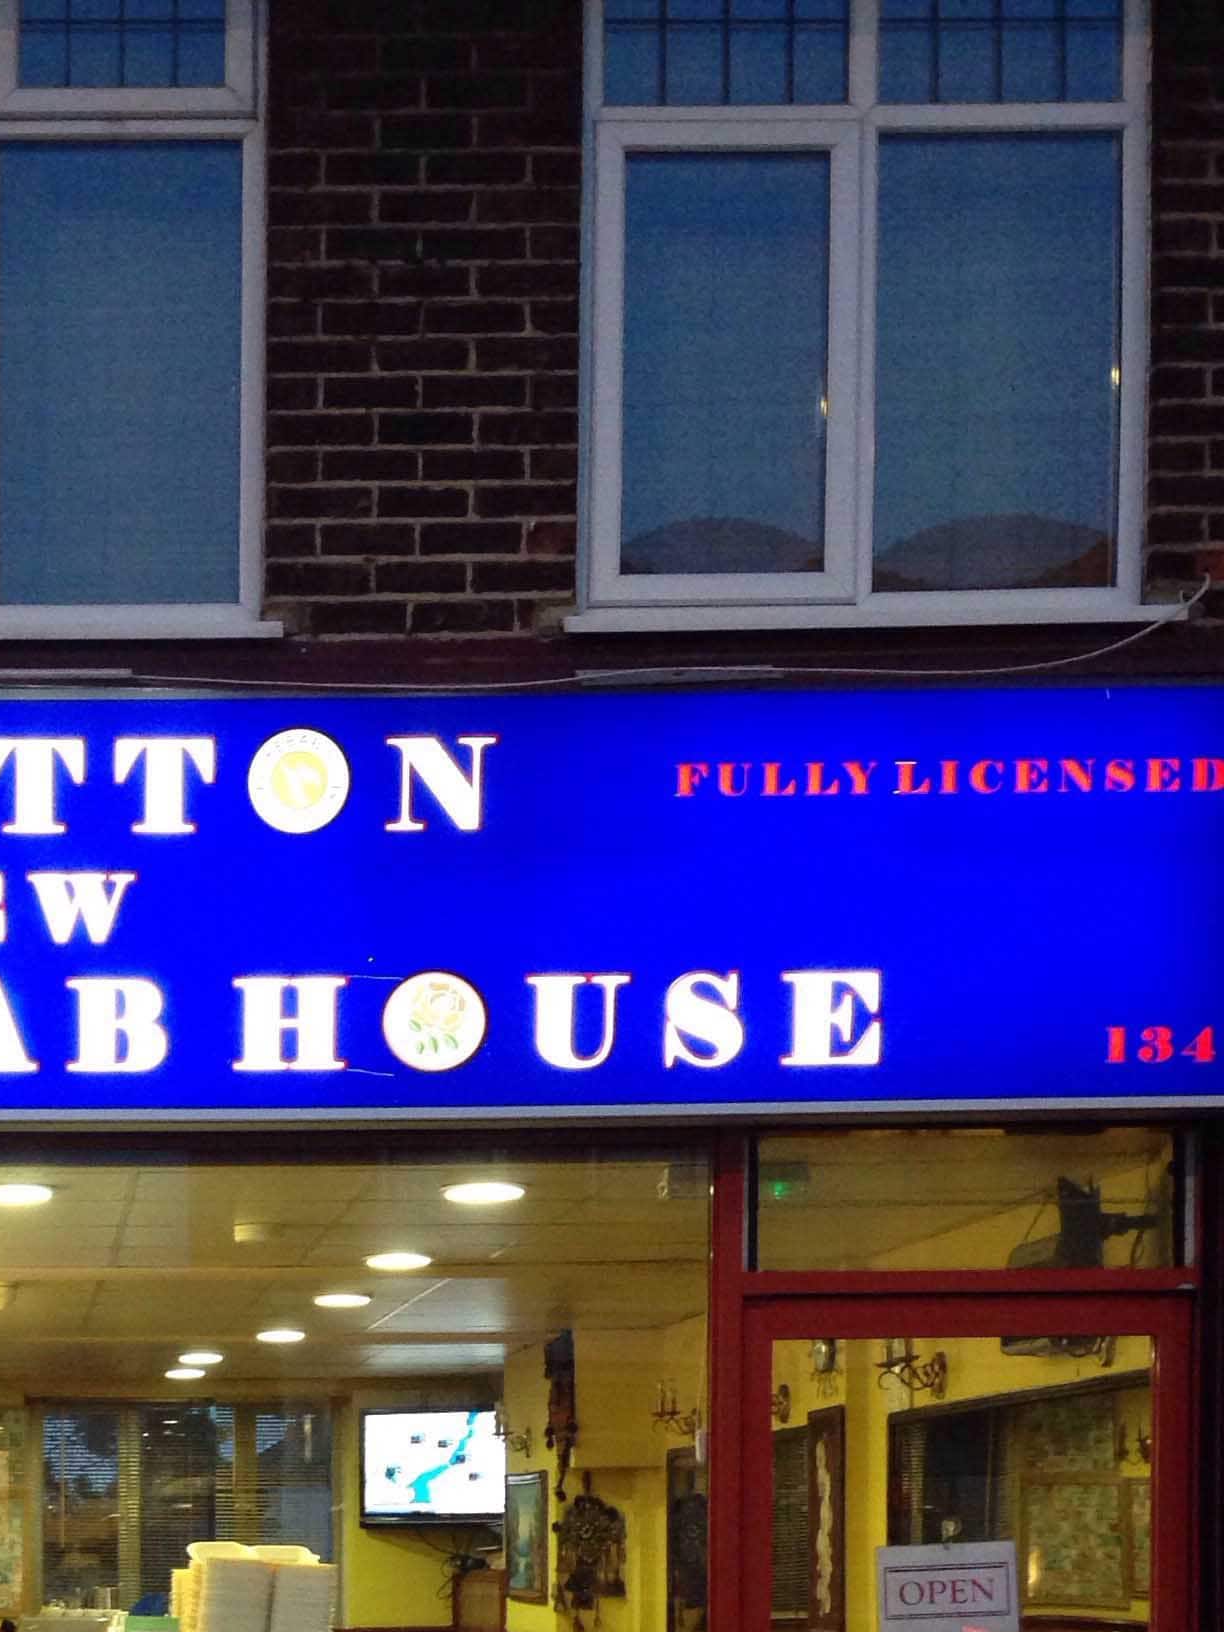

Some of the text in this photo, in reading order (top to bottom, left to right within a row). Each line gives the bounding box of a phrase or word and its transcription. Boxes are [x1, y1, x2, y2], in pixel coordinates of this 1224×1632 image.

[674, 757, 1223, 797] FULLY LICENSED
[232, 969, 883, 1073] HOUSE
[1105, 1026, 1216, 1064] 134
[899, 1577, 995, 1606] OPEN
